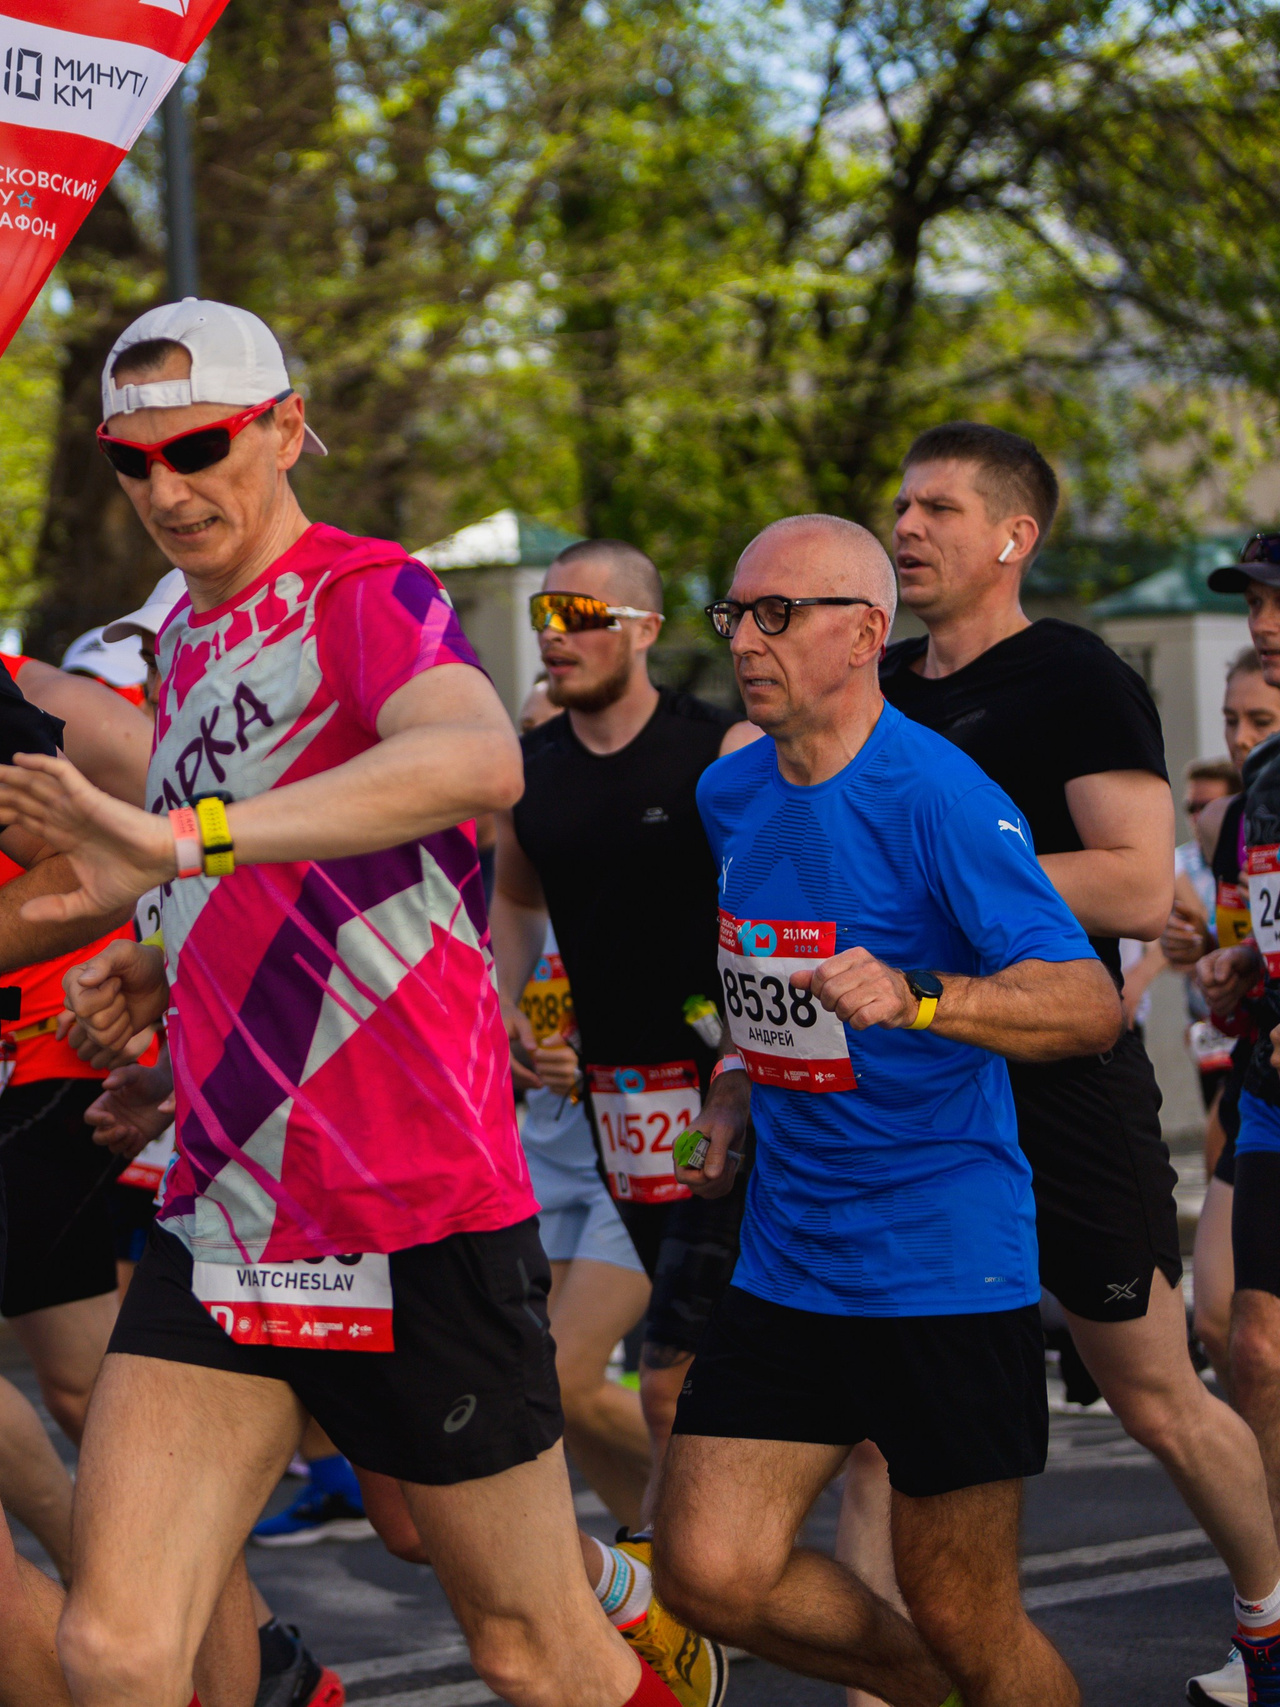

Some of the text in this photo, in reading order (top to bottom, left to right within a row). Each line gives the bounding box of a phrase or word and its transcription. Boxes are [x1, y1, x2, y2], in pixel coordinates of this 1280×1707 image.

[54, 83, 93, 110] КМ
[794, 944, 819, 953] 2024
[723, 967, 818, 1028] 8538
[748, 1026, 795, 1048] АНДРЕЙ
[236, 1269, 355, 1291] VIATCHESLAV
